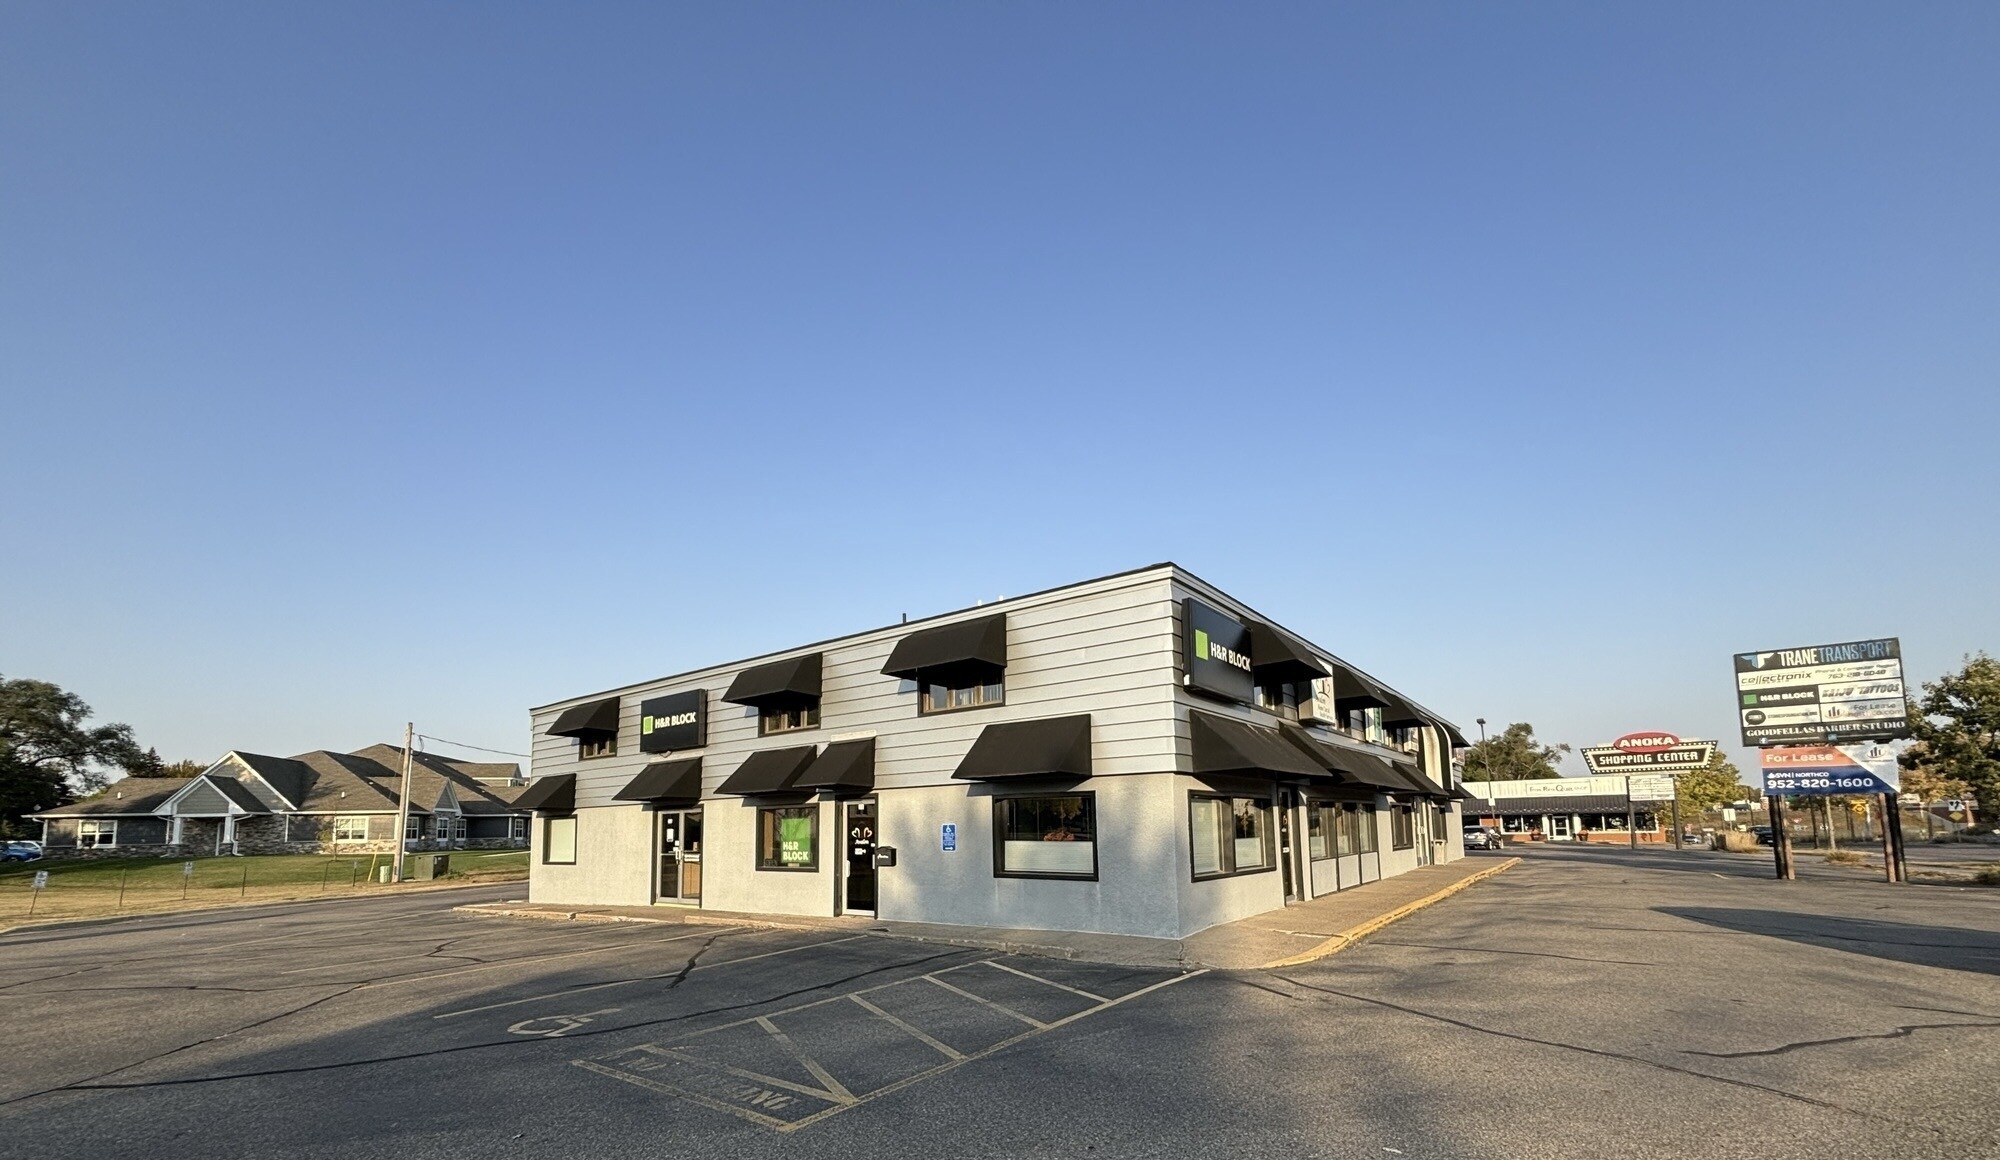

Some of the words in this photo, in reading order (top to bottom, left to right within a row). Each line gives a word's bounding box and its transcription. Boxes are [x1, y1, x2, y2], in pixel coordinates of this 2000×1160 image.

[1211, 642, 1227, 662] H&R
[1228, 649, 1251, 672] BLOCK
[1777, 648, 1819, 666] TRANE
[1818, 641, 1892, 662] TRANSPORT
[1782, 692, 1814, 700] BLOCK
[655, 716, 670, 729] H&R
[671, 712, 696, 726] BLOCK
[1746, 727, 1815, 736] GOODFELLAS
[1816, 723, 1860, 732] BARBER
[1862, 721, 1905, 730] STUDIO
[1619, 737, 1675, 748] ANOKA
[1599, 754, 1652, 765] SHOPPING
[1657, 751, 1698, 762] CENTER
[1766, 754, 1788, 762] For
[1792, 753, 1834, 762] Lease
[1767, 778, 1873, 788] 952-820-1600
[783, 841, 798, 850] H&R
[783, 851, 809, 860] BLOCK
